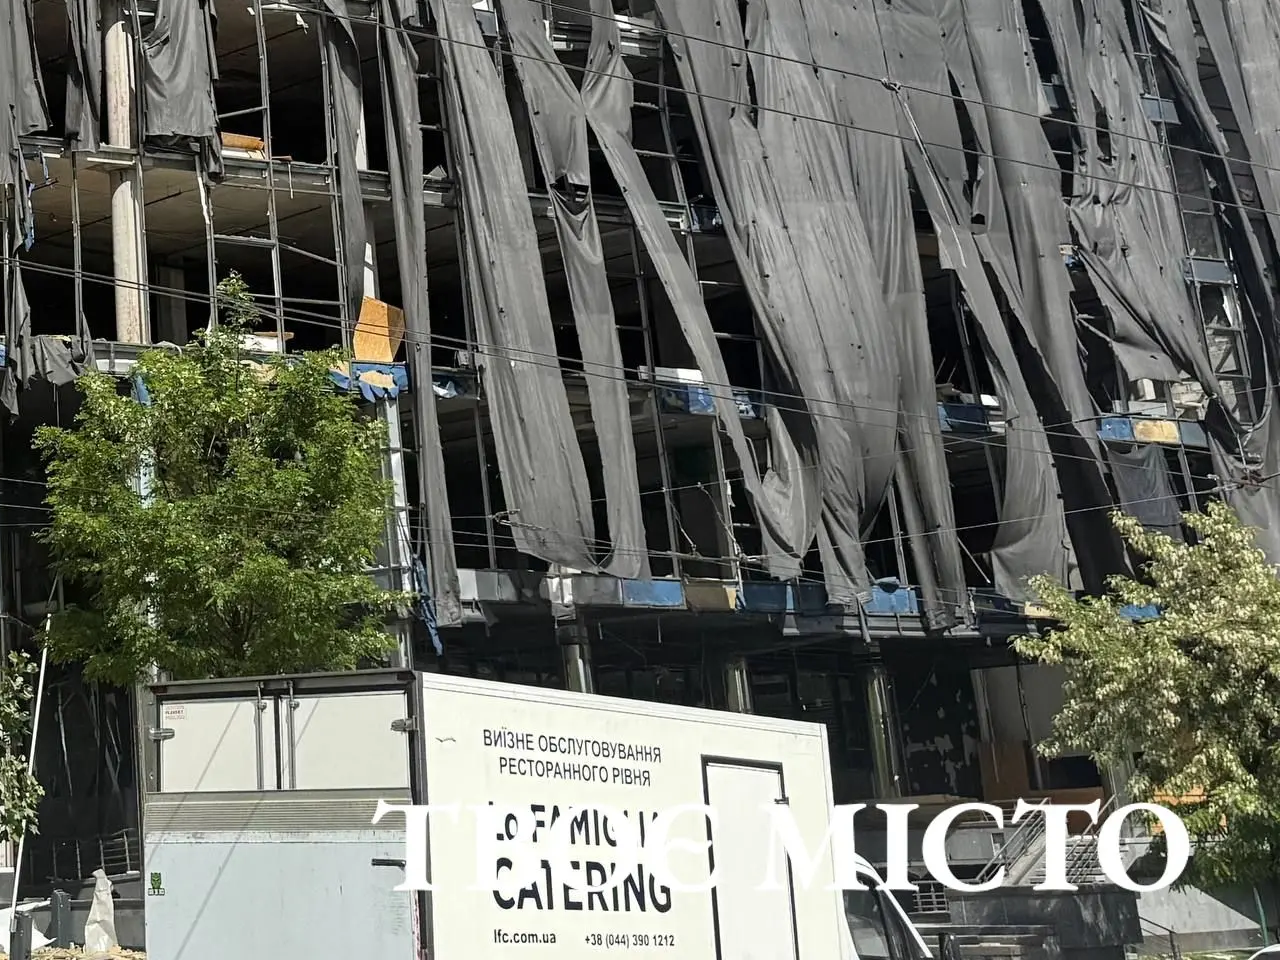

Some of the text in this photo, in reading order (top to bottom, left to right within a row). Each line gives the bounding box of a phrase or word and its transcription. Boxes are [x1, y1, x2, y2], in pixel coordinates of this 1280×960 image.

[483, 726, 662, 764] ВИЇЗНЕ ОБСЛУГОВУВАННЯ
[499, 756, 651, 787] РЕСТОРАННОГО РІВНЯ
[492, 857, 672, 913] CATERING
[493, 928, 675, 949] lfc.com.ua +38 (044) 390 1212
